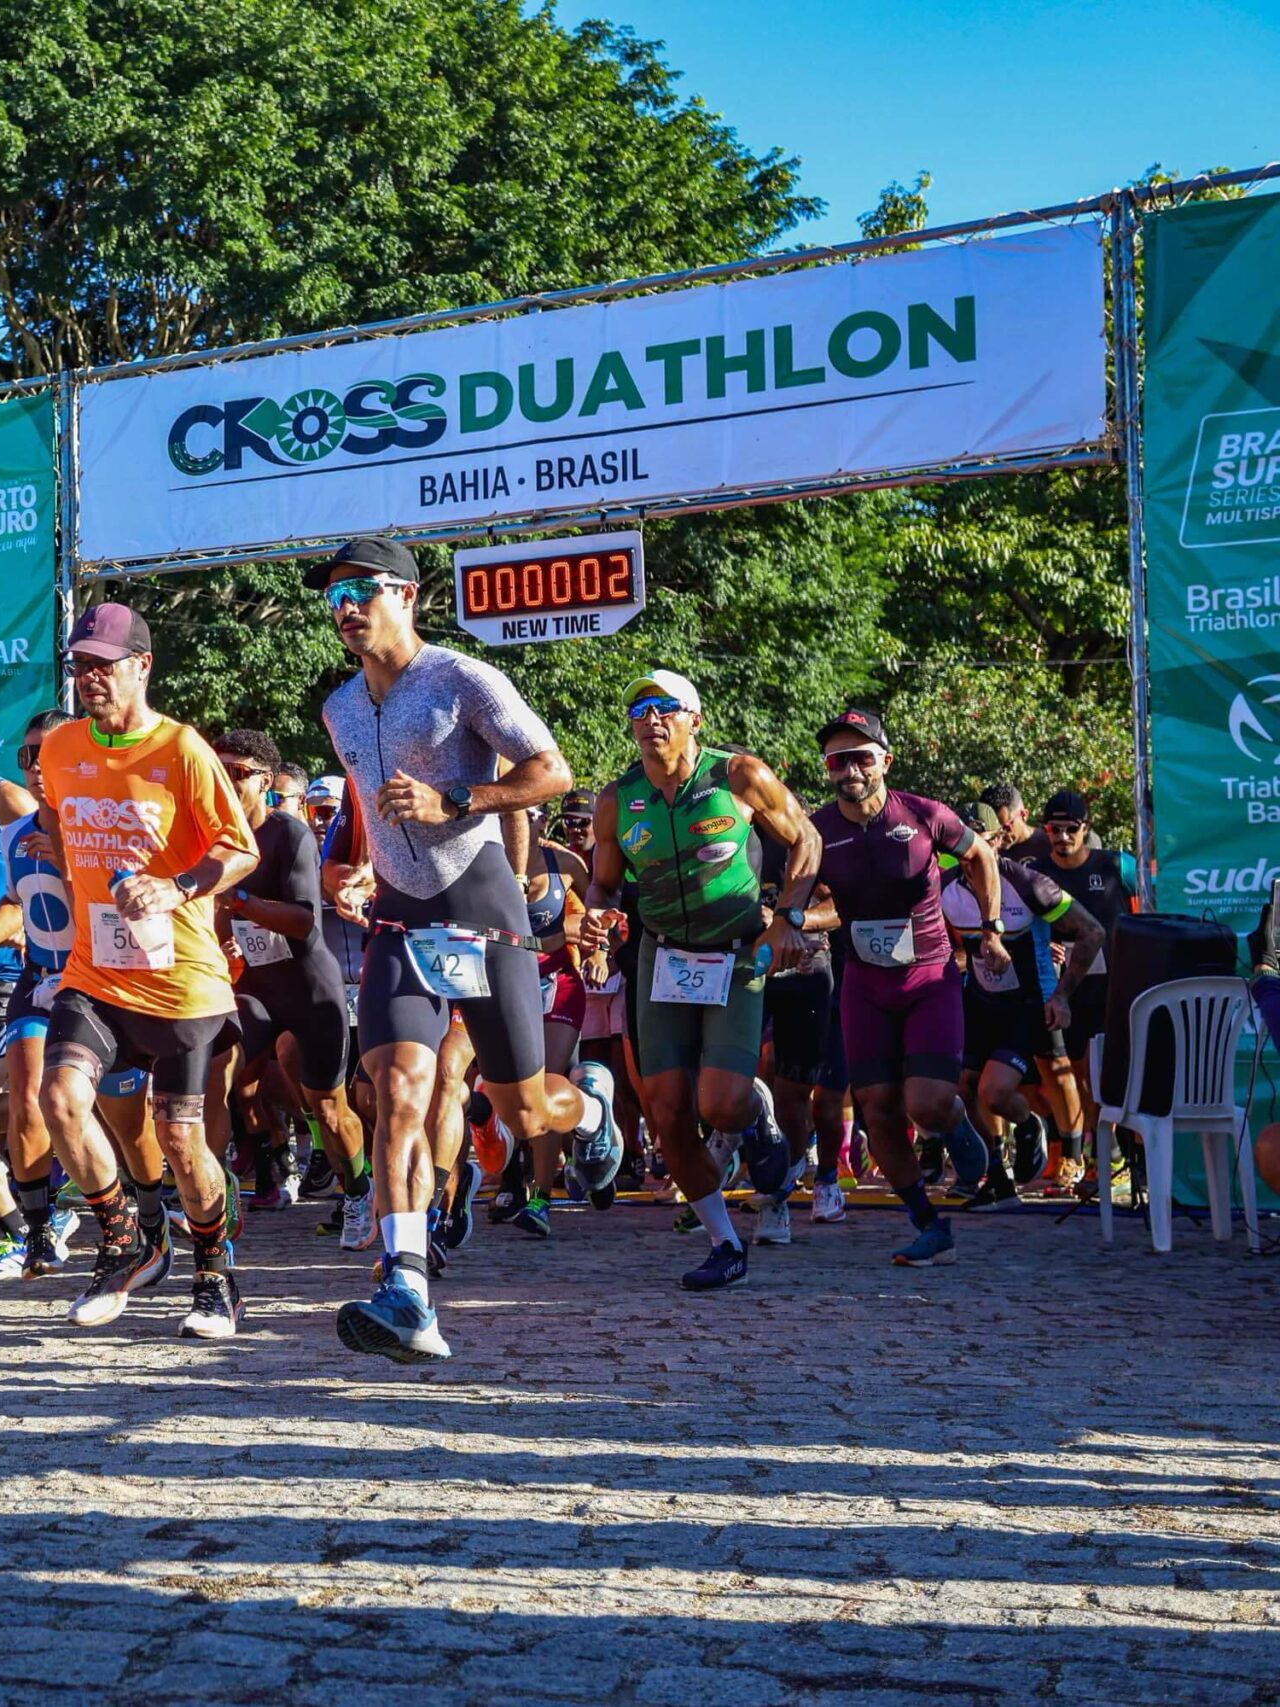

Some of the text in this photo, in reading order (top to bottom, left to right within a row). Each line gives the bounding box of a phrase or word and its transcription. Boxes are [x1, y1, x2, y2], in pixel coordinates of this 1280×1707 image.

[167, 295, 977, 476] CROSS DUATHLON
[420, 448, 649, 507] BAHIA BRASIL
[468, 555, 629, 612] 000002
[1187, 576, 1280, 613] Brasil
[502, 613, 601, 640] NEW TIME
[61, 796, 162, 832] CROSS
[66, 831, 159, 852] DUATHLON
[246, 936, 267, 953] 86
[870, 936, 895, 954] 65
[430, 953, 463, 978] 42
[676, 969, 705, 988] 25
